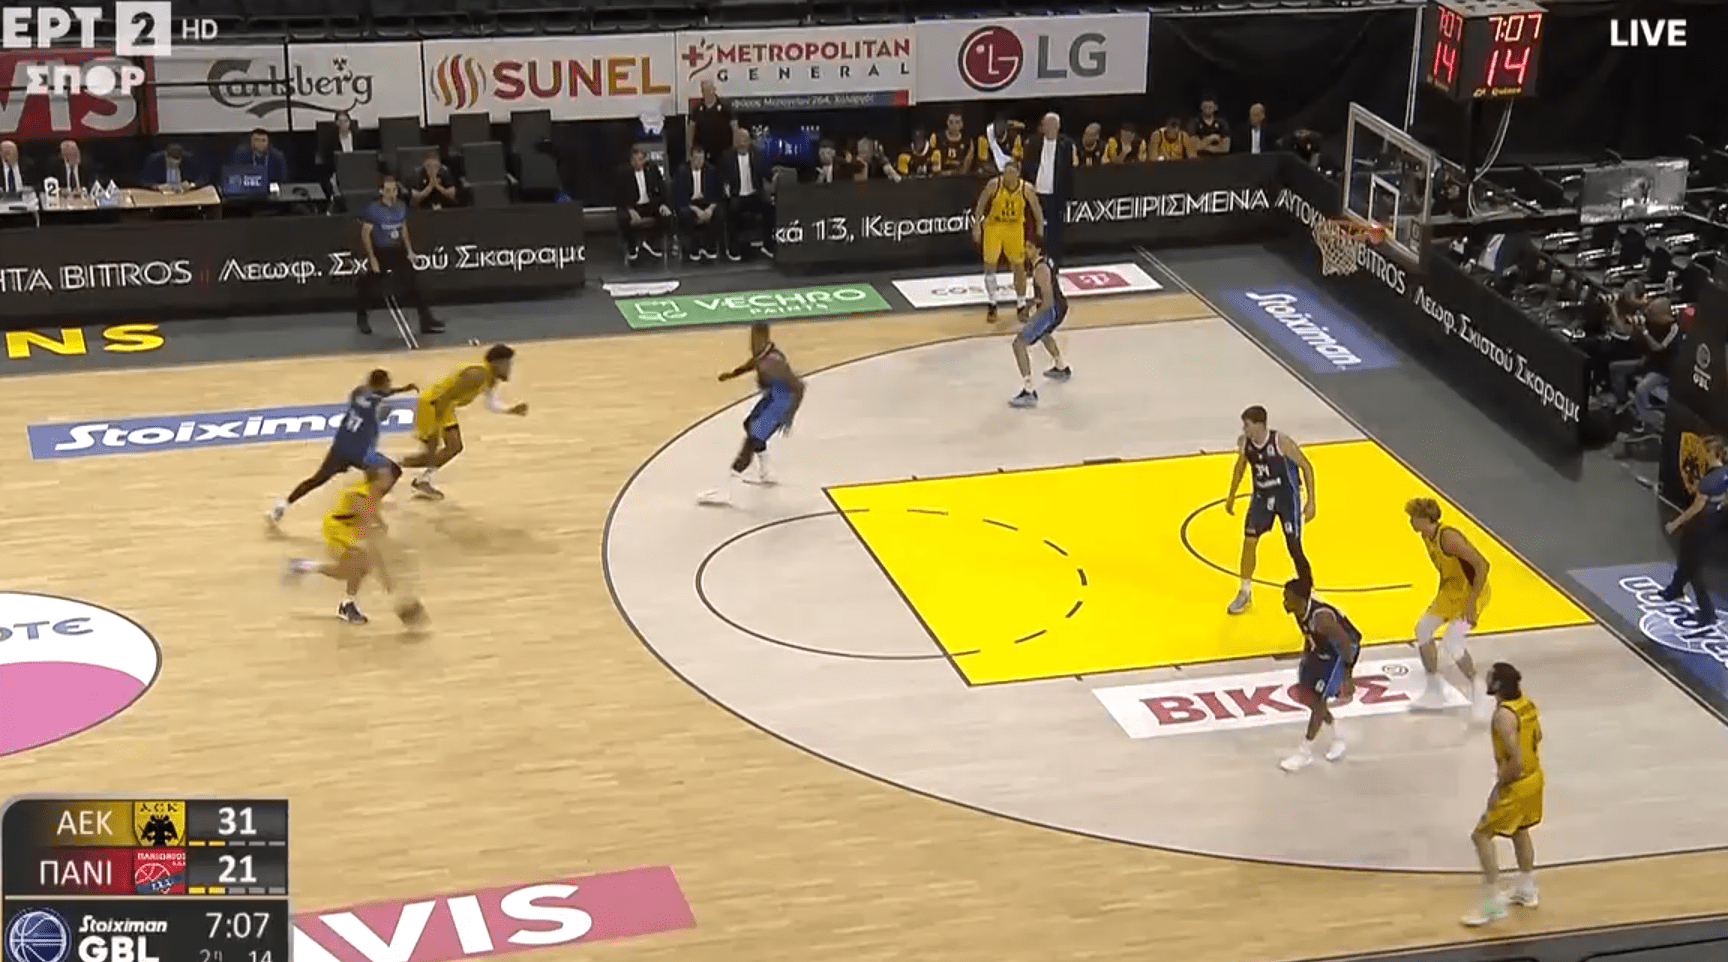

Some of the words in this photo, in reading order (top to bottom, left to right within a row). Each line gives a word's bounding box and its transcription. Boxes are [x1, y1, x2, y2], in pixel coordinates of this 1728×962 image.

[1488, 12, 1542, 42] 7:07
[716, 38, 910, 63] METROPOLITAN
[1037, 33, 1107, 79] LG
[492, 56, 671, 101] SUNEL
[716, 62, 910, 82] GENERAL
[1487, 46, 1530, 87] 14
[207, 58, 374, 108] Carlsberg
[59, 260, 193, 289] BITROS
[219, 258, 322, 283] Λεωφ.
[694, 288, 867, 310] VECHRO
